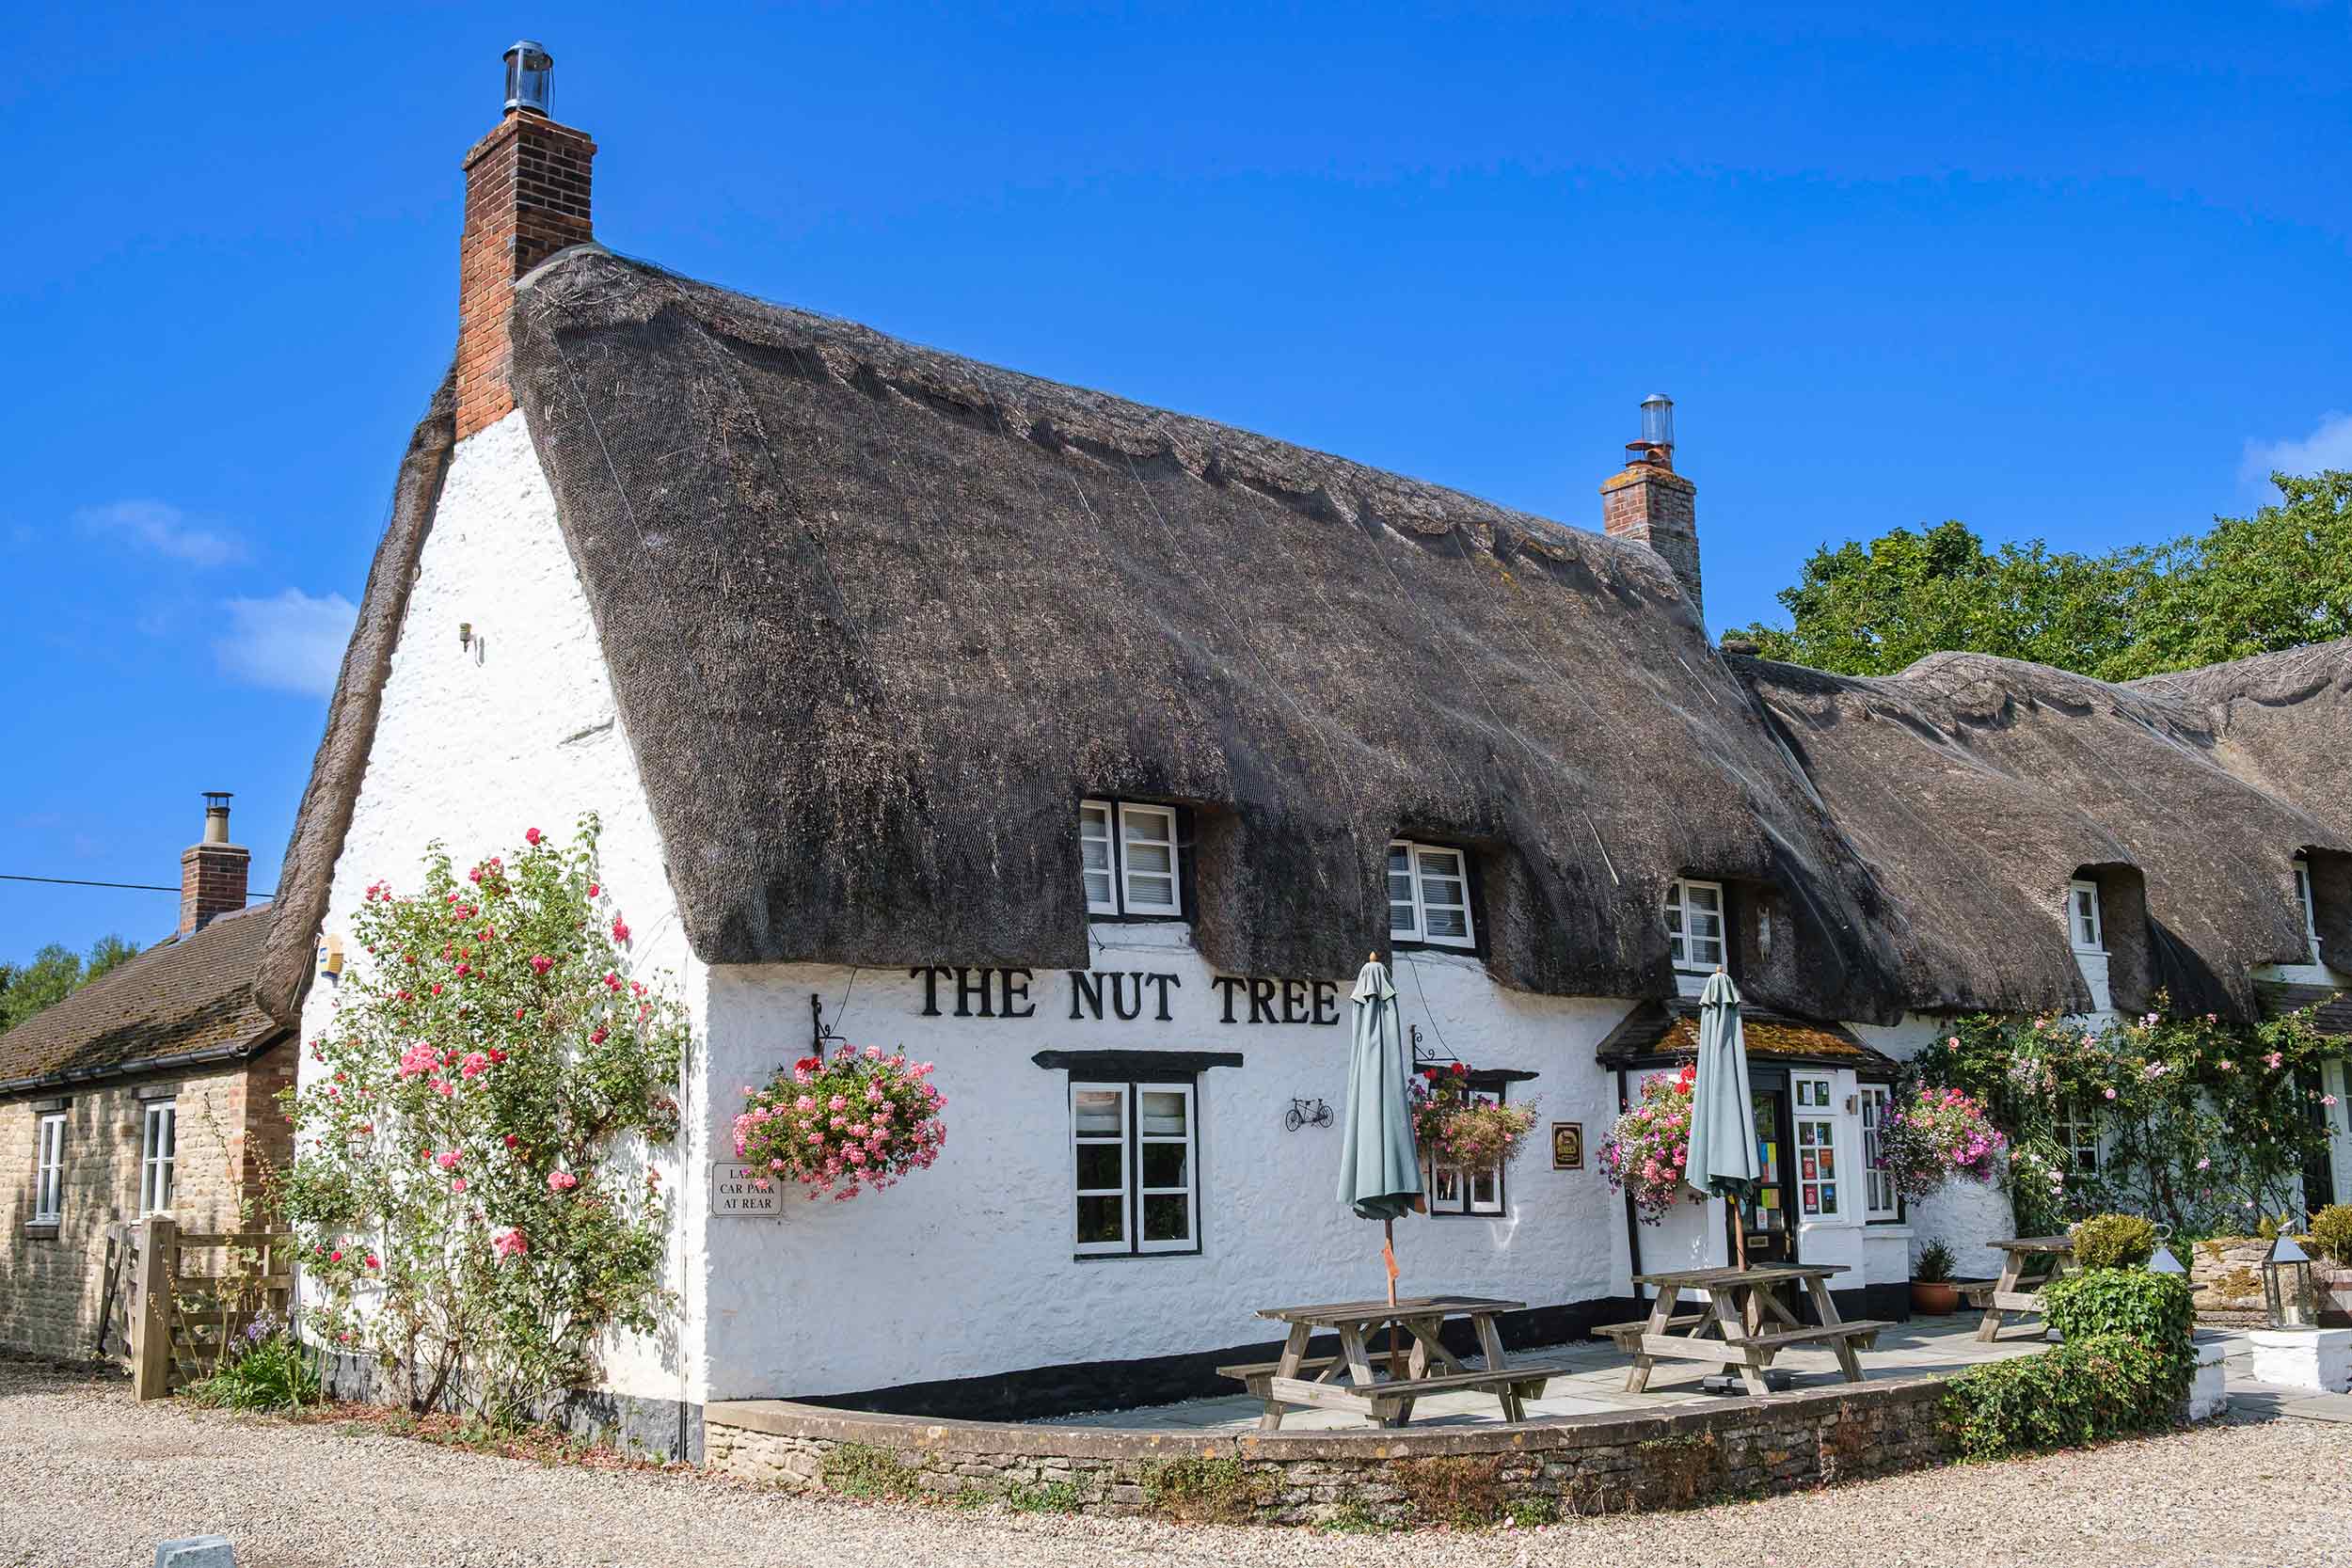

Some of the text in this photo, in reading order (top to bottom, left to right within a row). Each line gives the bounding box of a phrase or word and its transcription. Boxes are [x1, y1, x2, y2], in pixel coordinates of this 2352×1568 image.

[910, 967, 1341, 1026] THE NUT TREE
[720, 1184, 743, 1194] CAR
[723, 1198, 772, 1209] AT REAR
